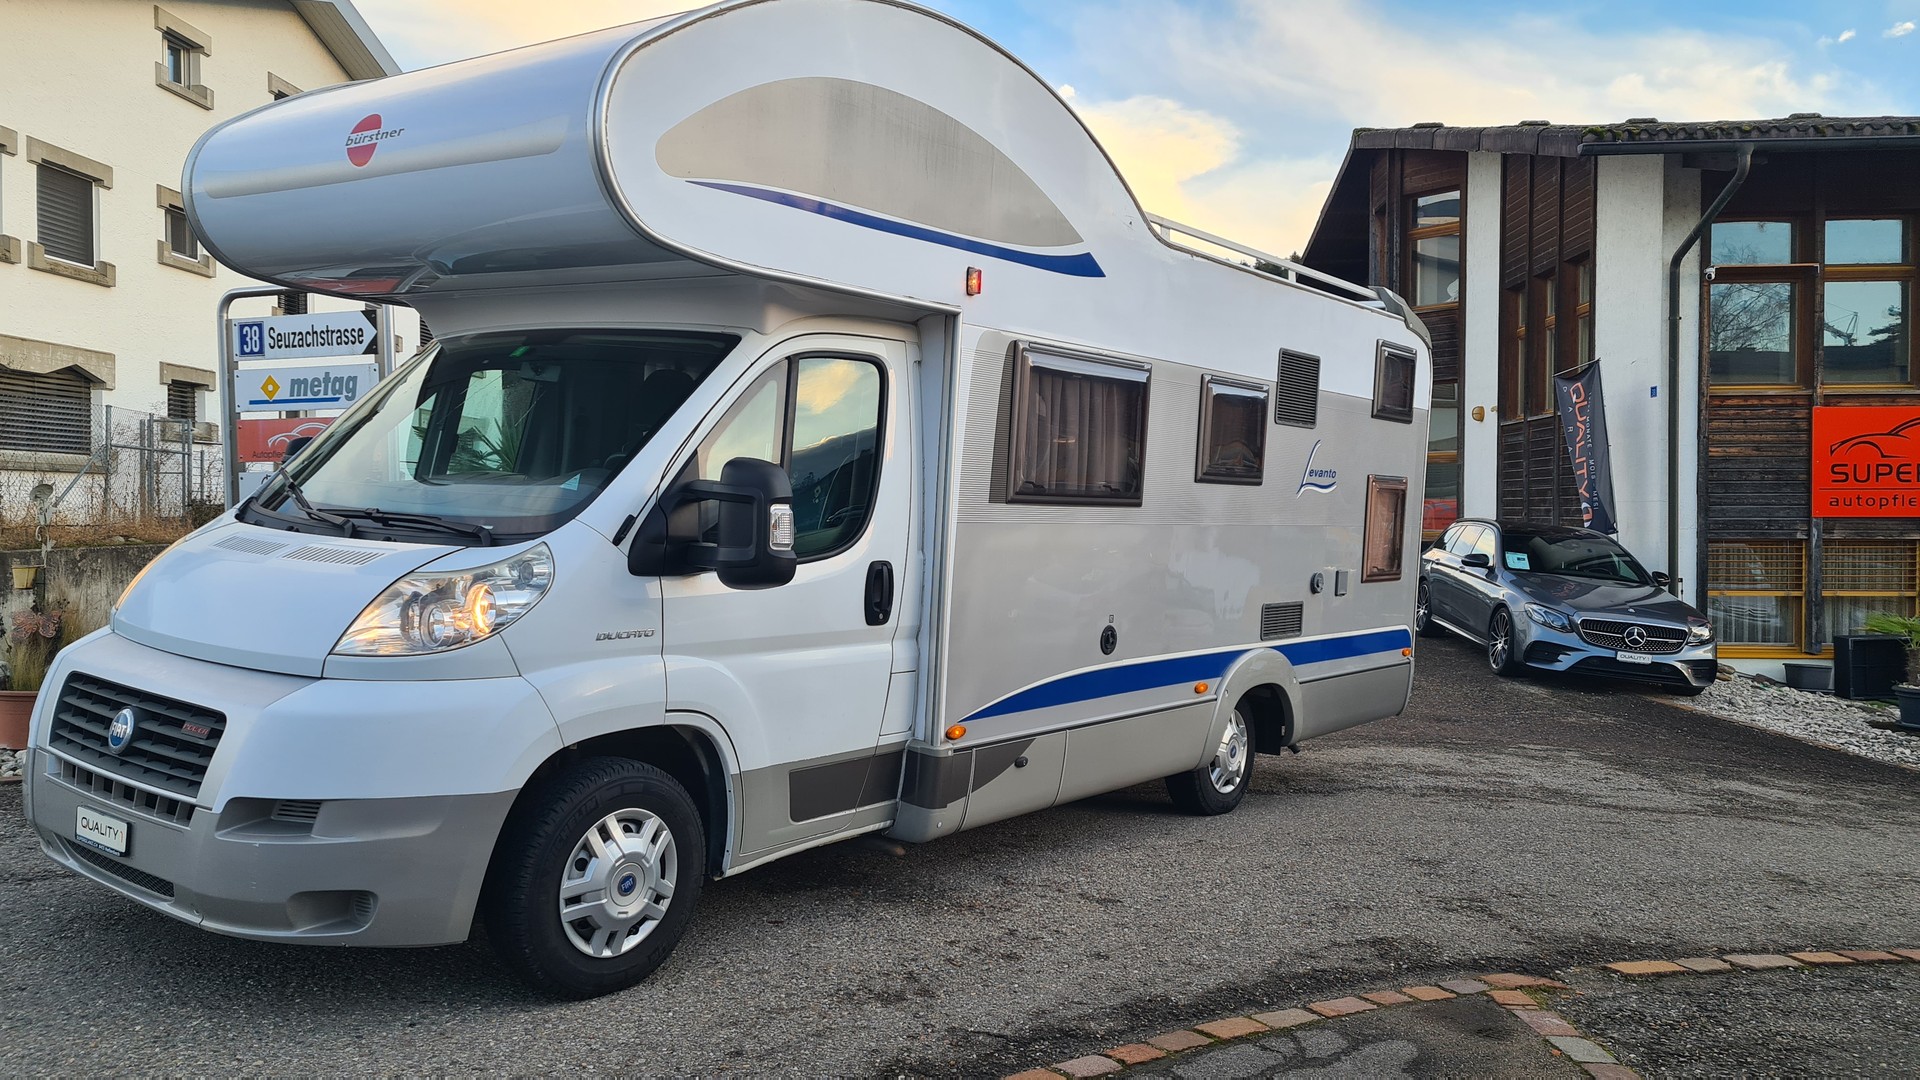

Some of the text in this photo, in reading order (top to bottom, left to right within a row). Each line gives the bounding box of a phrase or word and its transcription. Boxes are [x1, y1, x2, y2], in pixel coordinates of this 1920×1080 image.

[345, 128, 405, 147] bürstner
[242, 325, 364, 353] 38 Seuzachstrasse
[289, 371, 358, 401] metag
[1830, 463, 1920, 483] SUPE
[595, 628, 656, 641] DUCATO
[110, 722, 127, 738] FIAT
[621, 878, 634, 891] FIAT
